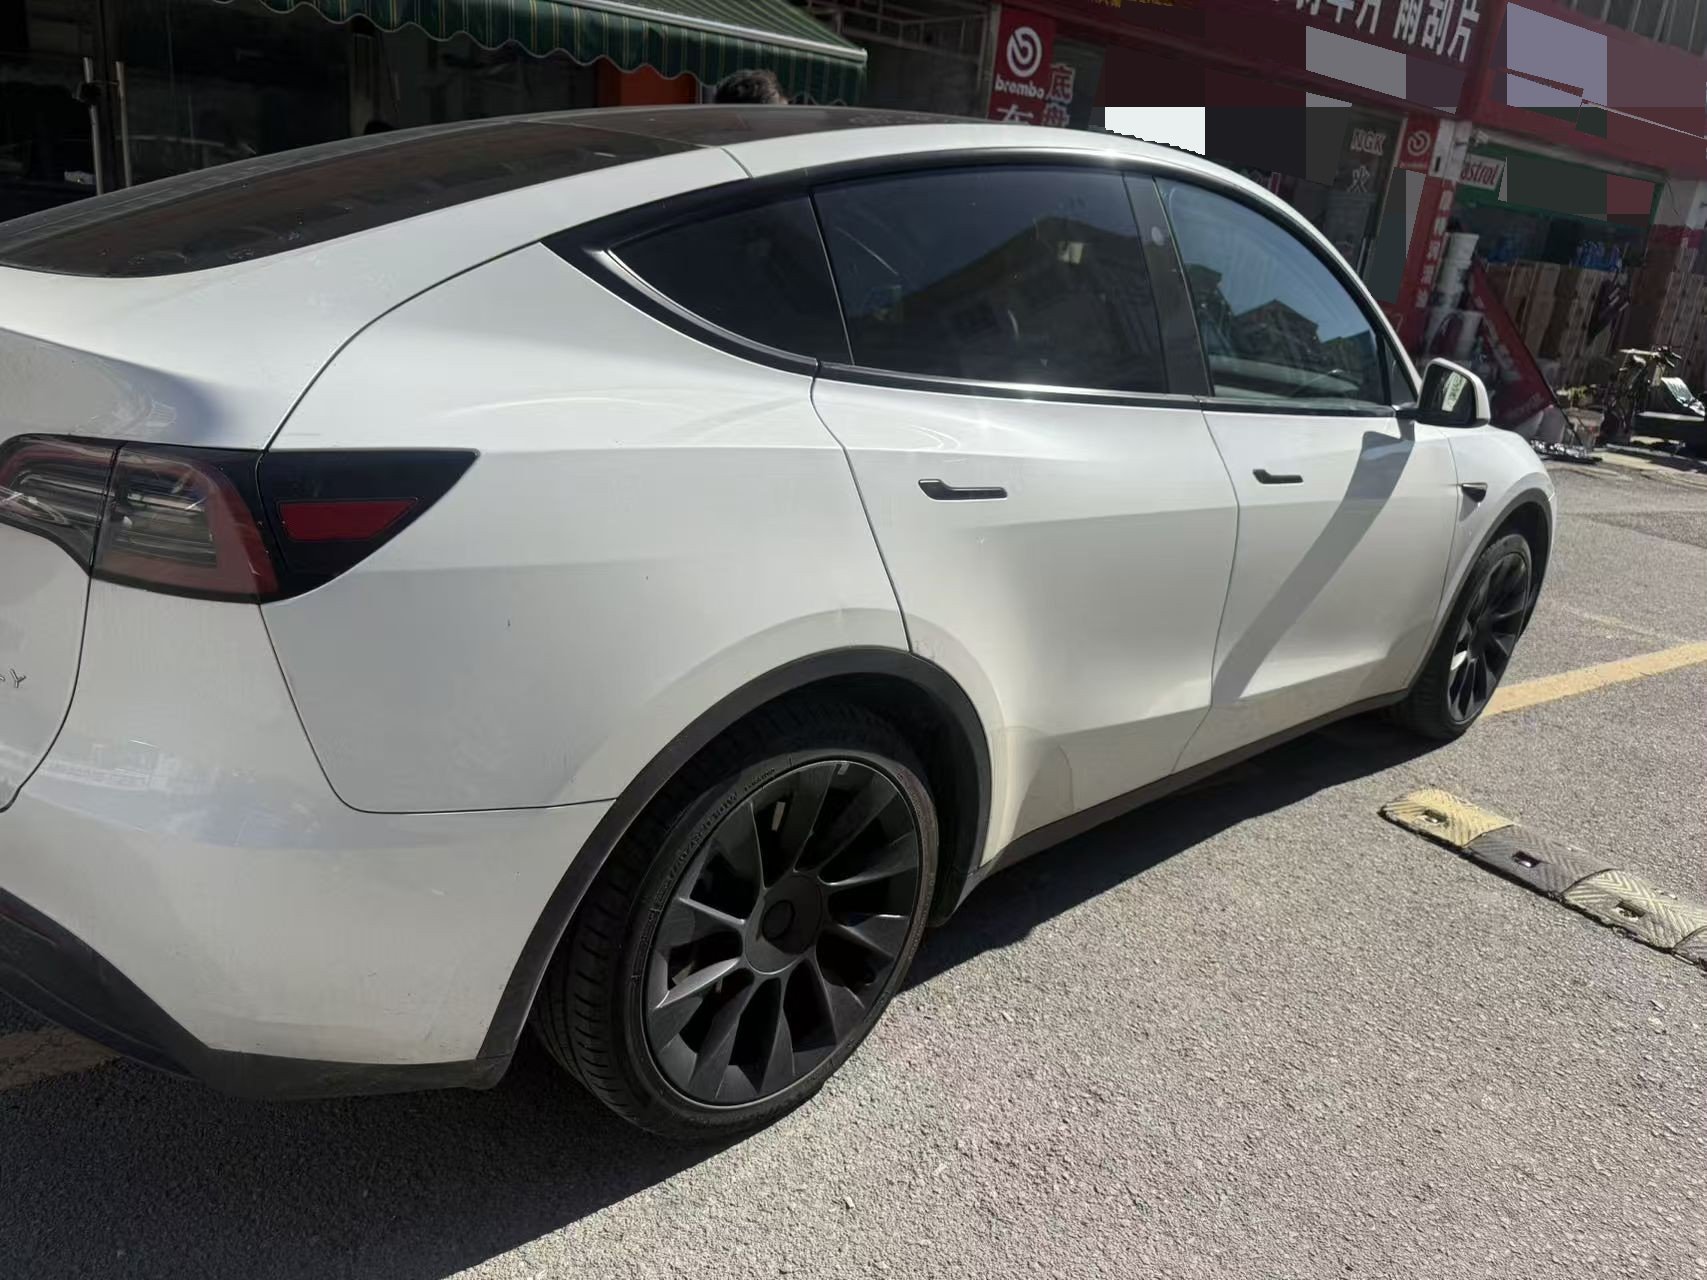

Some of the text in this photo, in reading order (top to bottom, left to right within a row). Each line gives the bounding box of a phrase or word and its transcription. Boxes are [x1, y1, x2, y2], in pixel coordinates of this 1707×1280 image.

[994, 73, 1045, 100] brembo
[1350, 128, 1386, 156] NGK
[1460, 161, 1499, 185] astrol
[9, 668, 27, 688] Y
